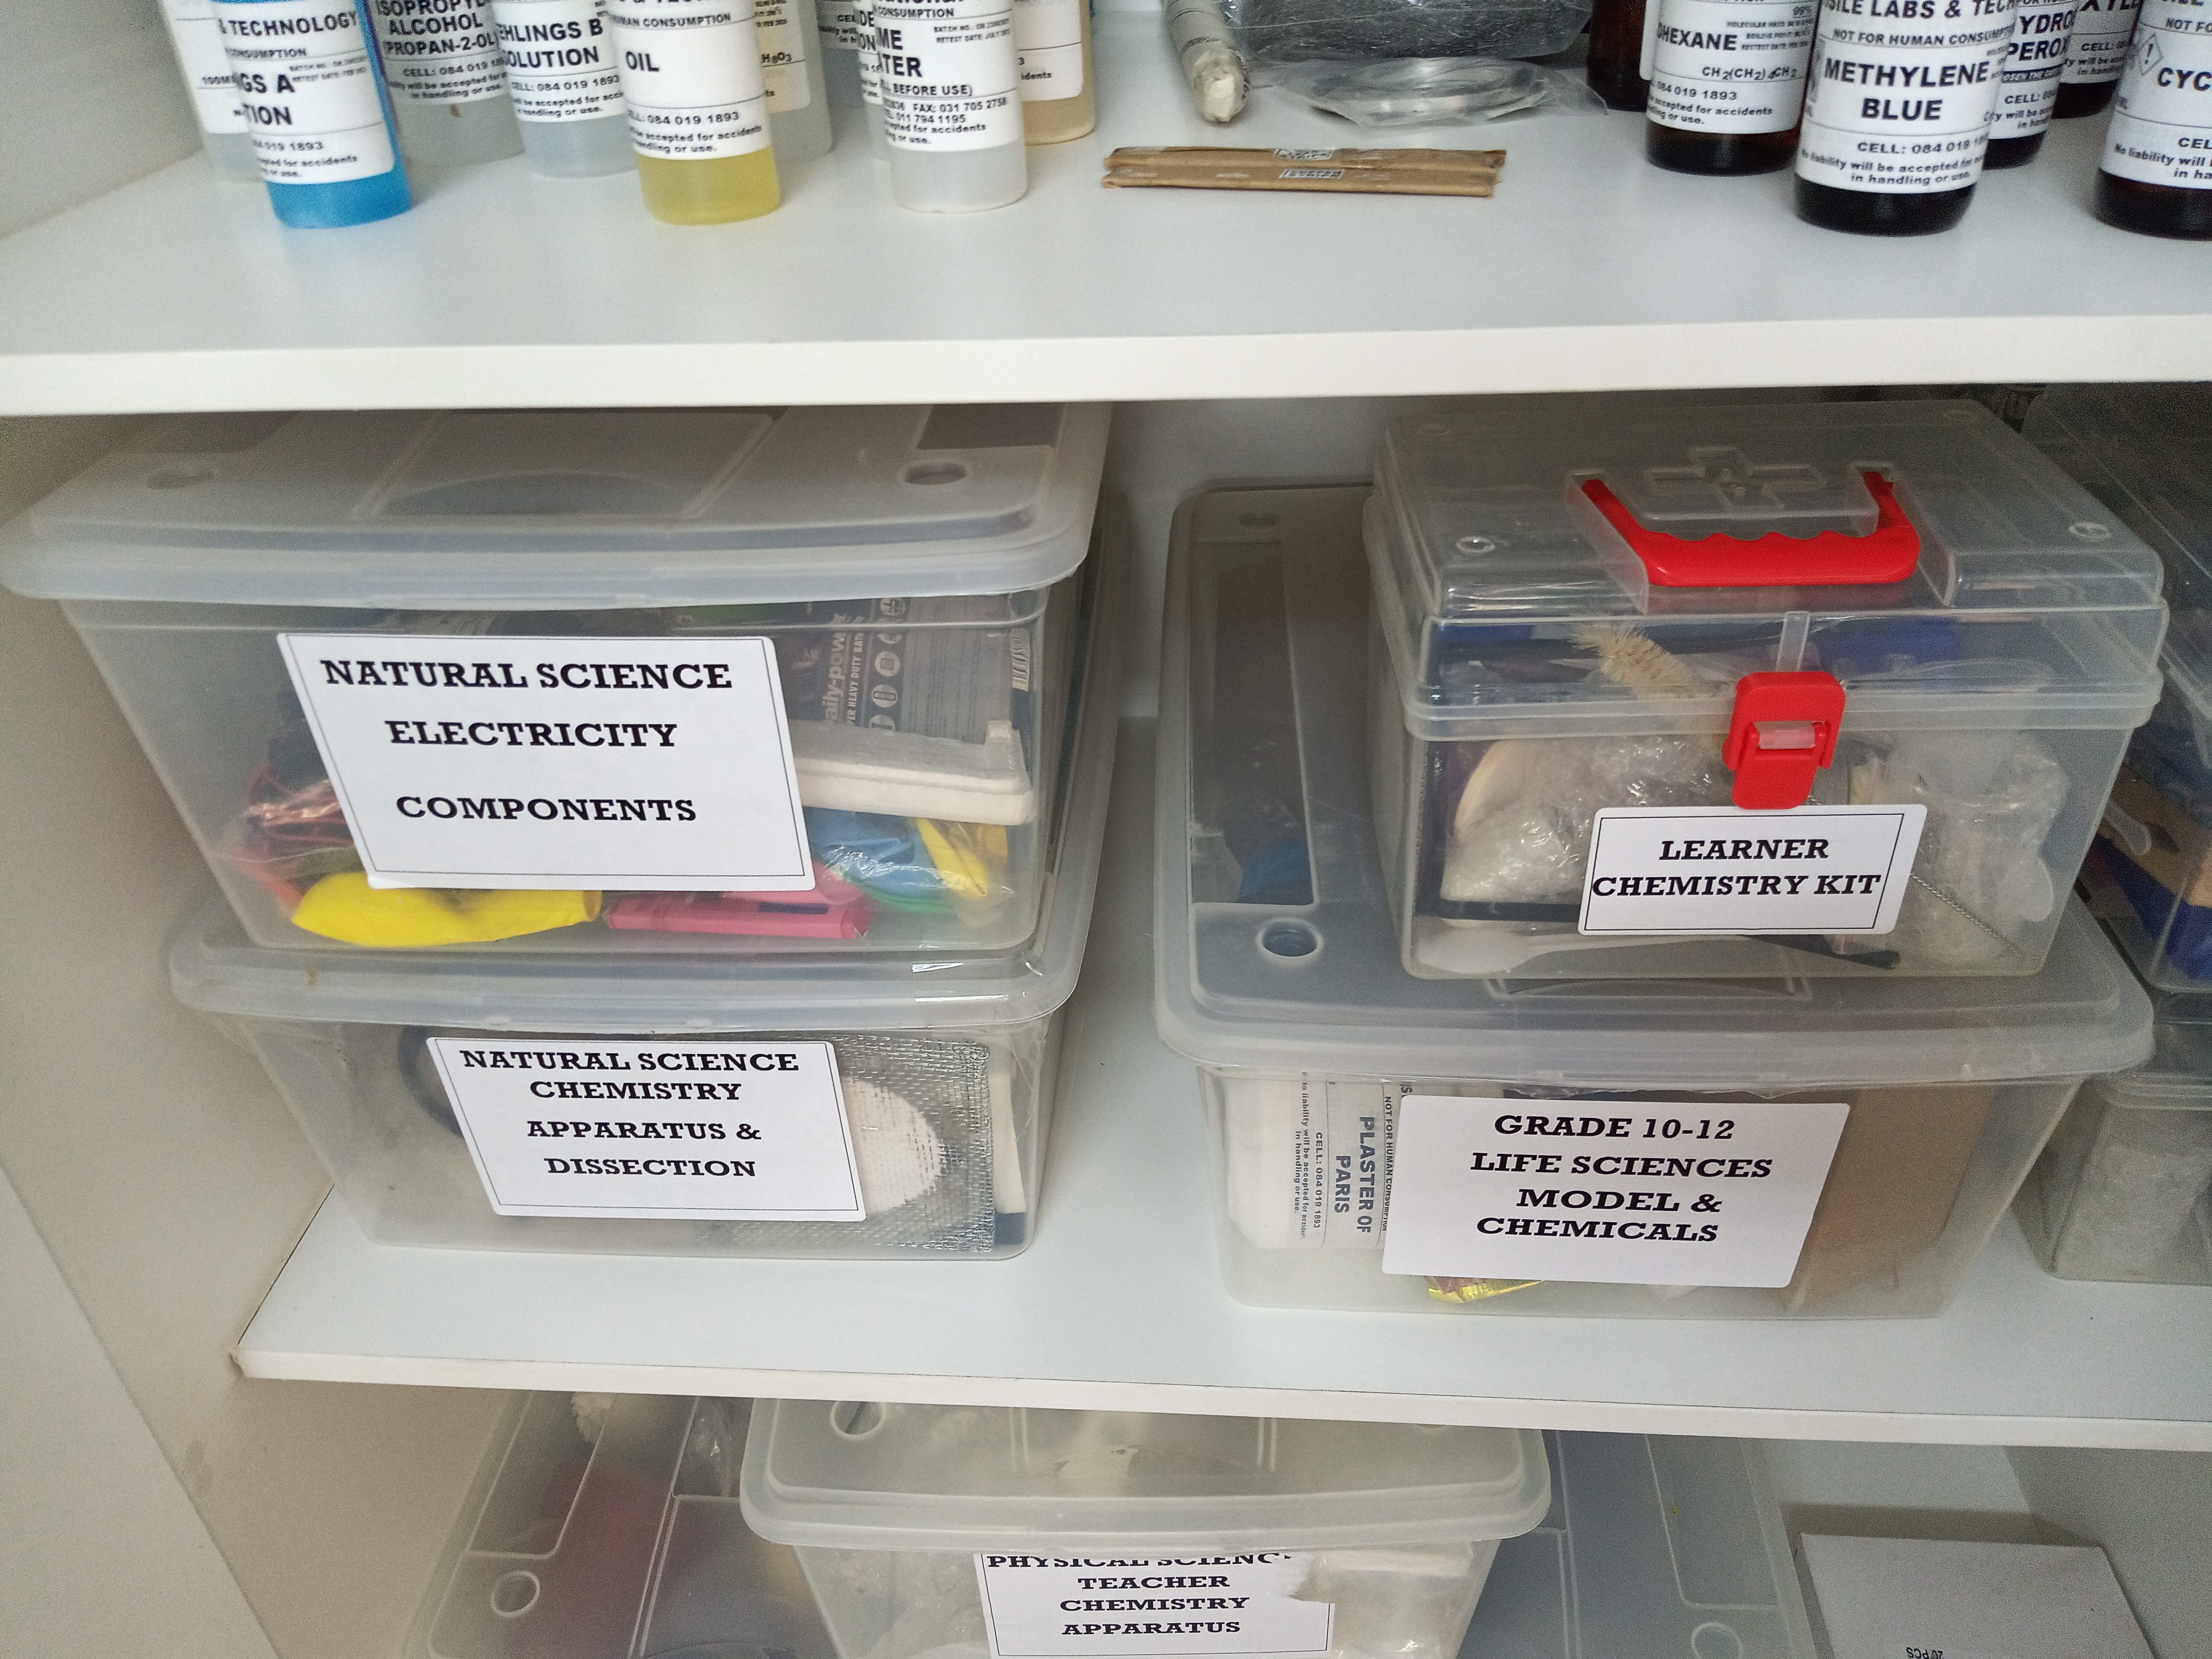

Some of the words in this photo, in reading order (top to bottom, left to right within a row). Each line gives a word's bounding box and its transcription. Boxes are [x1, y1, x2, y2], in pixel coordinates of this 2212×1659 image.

[1871, 0, 1936, 19] LABS
[1944, 0, 1962, 18] &
[228, 10, 358, 36] TECHNOLOGY
[389, 13, 483, 35] ALCOHOL
[588, 18, 604, 36] B
[643, 13, 731, 27] CONSUMPTION
[2018, 10, 2075, 35] YDRO
[2166, 17, 2192, 30] NOT
[1834, 29, 1856, 41] NOT
[1859, 32, 1885, 43] FOR
[1889, 35, 1945, 45] HUMAN
[503, 45, 600, 68] OLUTION
[625, 51, 660, 72] OIL
[439, 65, 464, 76] 084
[1824, 58, 1990, 87] METHYLENE
[276, 73, 296, 94] A
[537, 83, 561, 92] 084
[564, 80, 588, 91] 019
[592, 74, 620, 87] 1893
[893, 83, 937, 96] BEFORE
[941, 84, 973, 97] USE)
[1674, 86, 1697, 98] 019
[1702, 90, 1738, 101] 1893
[913, 102, 936, 113] FAX:
[939, 103, 960, 113] 031
[963, 101, 982, 111] 705
[1696, 105, 1712, 114] for
[1715, 108, 1773, 116] accidents
[1860, 98, 1943, 121] BLUE
[675, 115, 702, 125] 019
[707, 111, 740, 124] 1893
[914, 113, 934, 124] 794
[938, 113, 966, 124] 1195
[697, 132, 713, 141] for
[931, 123, 987, 134] accidents
[290, 140, 324, 151] 1893
[1857, 141, 1906, 154] CELL:
[1911, 143, 1942, 154] 084
[1946, 139, 1970, 152] 019
[1850, 161, 1873, 170] will
[1877, 163, 1894, 172] be
[1899, 157, 1958, 173] accepted
[2179, 156, 2206, 166] will
[1851, 174, 1863, 182] in
[1868, 174, 1930, 187] handling
[1934, 175, 1949, 183] or
[2174, 168, 2188, 178] in
[320, 660, 528, 688] NATURAL
[537, 664, 732, 689] SCIENCE
[822, 614, 847, 723] aily-pow
[850, 655, 861, 679] DUTY
[847, 680, 858, 707] HEAVY
[385, 720, 677, 747] ELECTRICITY
[396, 796, 696, 821] COMPONENTS
[1659, 839, 1829, 861] LEARNER
[1592, 875, 1809, 896] CHEMISTRY
[1814, 874, 1881, 895] KIT
[460, 1050, 630, 1070] NATURAL
[639, 1053, 799, 1071] SCIENCE
[530, 1081, 741, 1100] CHEMISTRY
[1384, 1096, 1392, 1116] NOT
[527, 1121, 726, 1140] APPARATUS
[735, 1123, 762, 1140] &
[1296, 1131, 1301, 1140] in
[1494, 1114, 1632, 1138] GRADE
[1641, 1119, 1735, 1139] 10-12
[1303, 1147, 1310, 1159] be
[1315, 1132, 1323, 1164] CELL:
[543, 1158, 756, 1176] DISSECTION
[1358, 1116, 1376, 1211] PLASTER
[1470, 1152, 1562, 1173] LIFE
[1571, 1155, 1773, 1178] SCIENCES
[1301, 1162, 1310, 1201] accepted
[1334, 1155, 1351, 1214] PARIS
[1295, 1186, 1300, 1196] or
[1516, 1189, 1680, 1212] MODEL
[1690, 1194, 1722, 1213] &
[1356, 1215, 1373, 1233] OF
[1477, 1217, 1719, 1242] CHEMICALS
[1158, 1553, 1292, 1566] SCIENC
[1077, 1576, 1230, 1590] TEACHER
[1059, 1597, 1250, 1611] CHEMISTRY
[1062, 1621, 1241, 1635] APPARATUS
[1906, 1647, 1929, 1659] PCS
